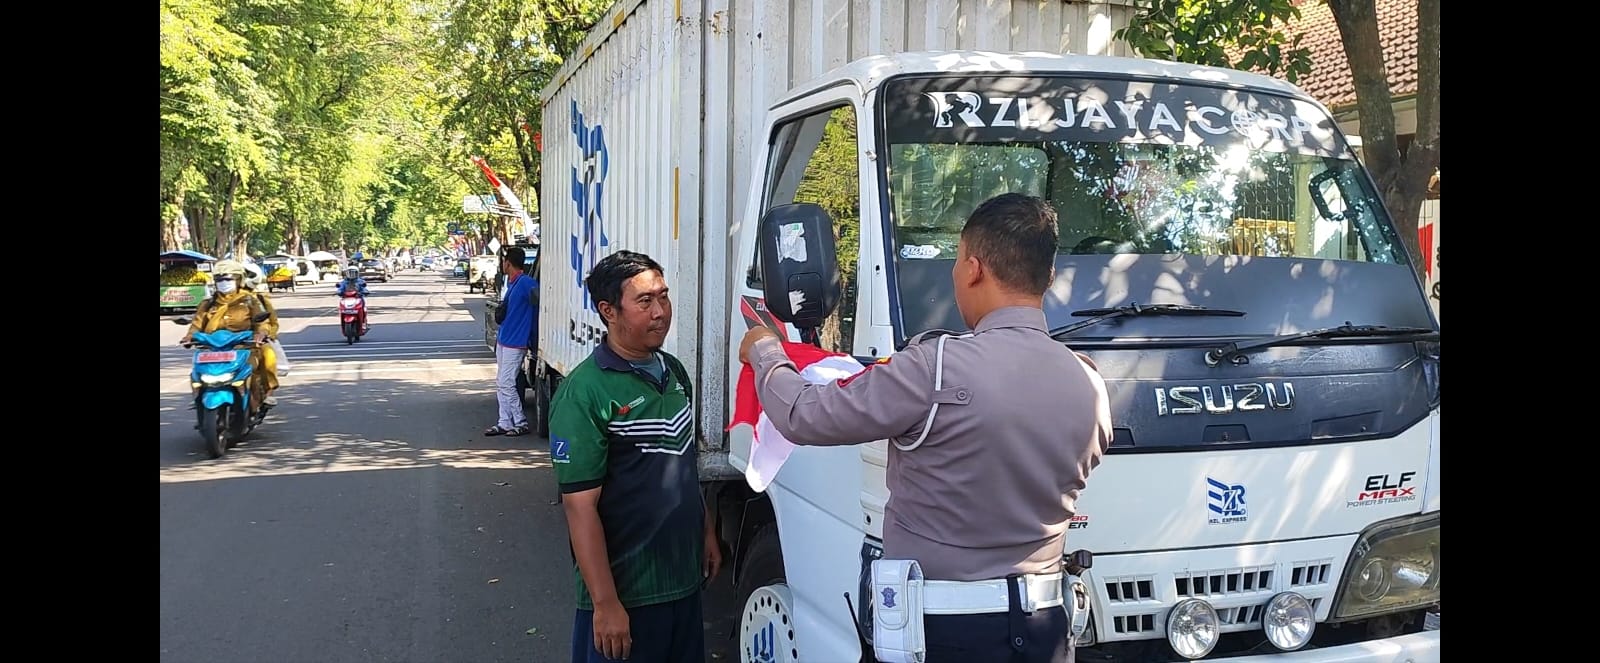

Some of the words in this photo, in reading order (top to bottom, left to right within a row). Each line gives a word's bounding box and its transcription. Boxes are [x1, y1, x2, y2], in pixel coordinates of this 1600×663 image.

[1056, 98, 1182, 131] JAYA
[1155, 382, 1295, 416] ISUZU
[1365, 471, 1416, 491] ELF
[1359, 487, 1415, 500] MAX
[1347, 500, 1377, 508] POWER
[1068, 521, 1088, 529] ER
